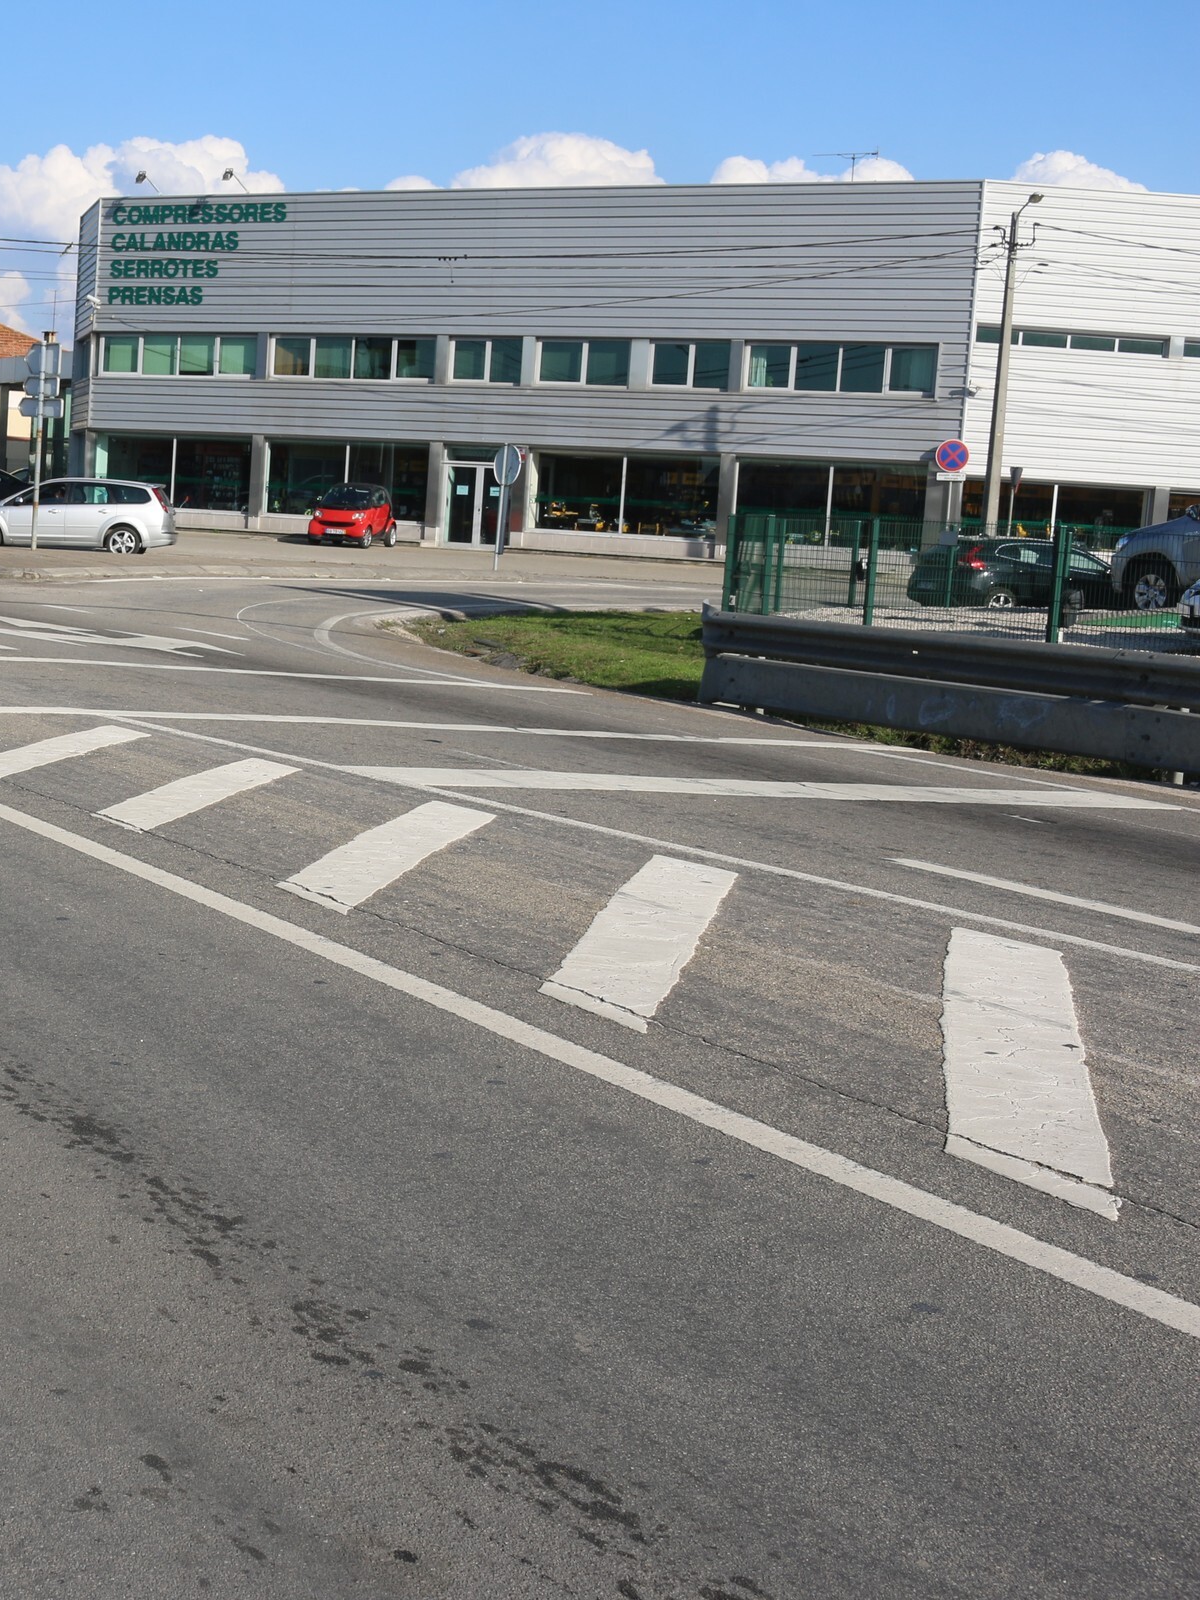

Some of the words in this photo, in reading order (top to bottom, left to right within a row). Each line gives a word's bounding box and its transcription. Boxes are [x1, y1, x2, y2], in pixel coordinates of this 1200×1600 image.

[112, 202, 287, 226] COMPRESSORES
[111, 231, 239, 252] CALANDRAS
[109, 258, 219, 279] SERROTES
[107, 286, 203, 306] PRENSAS
